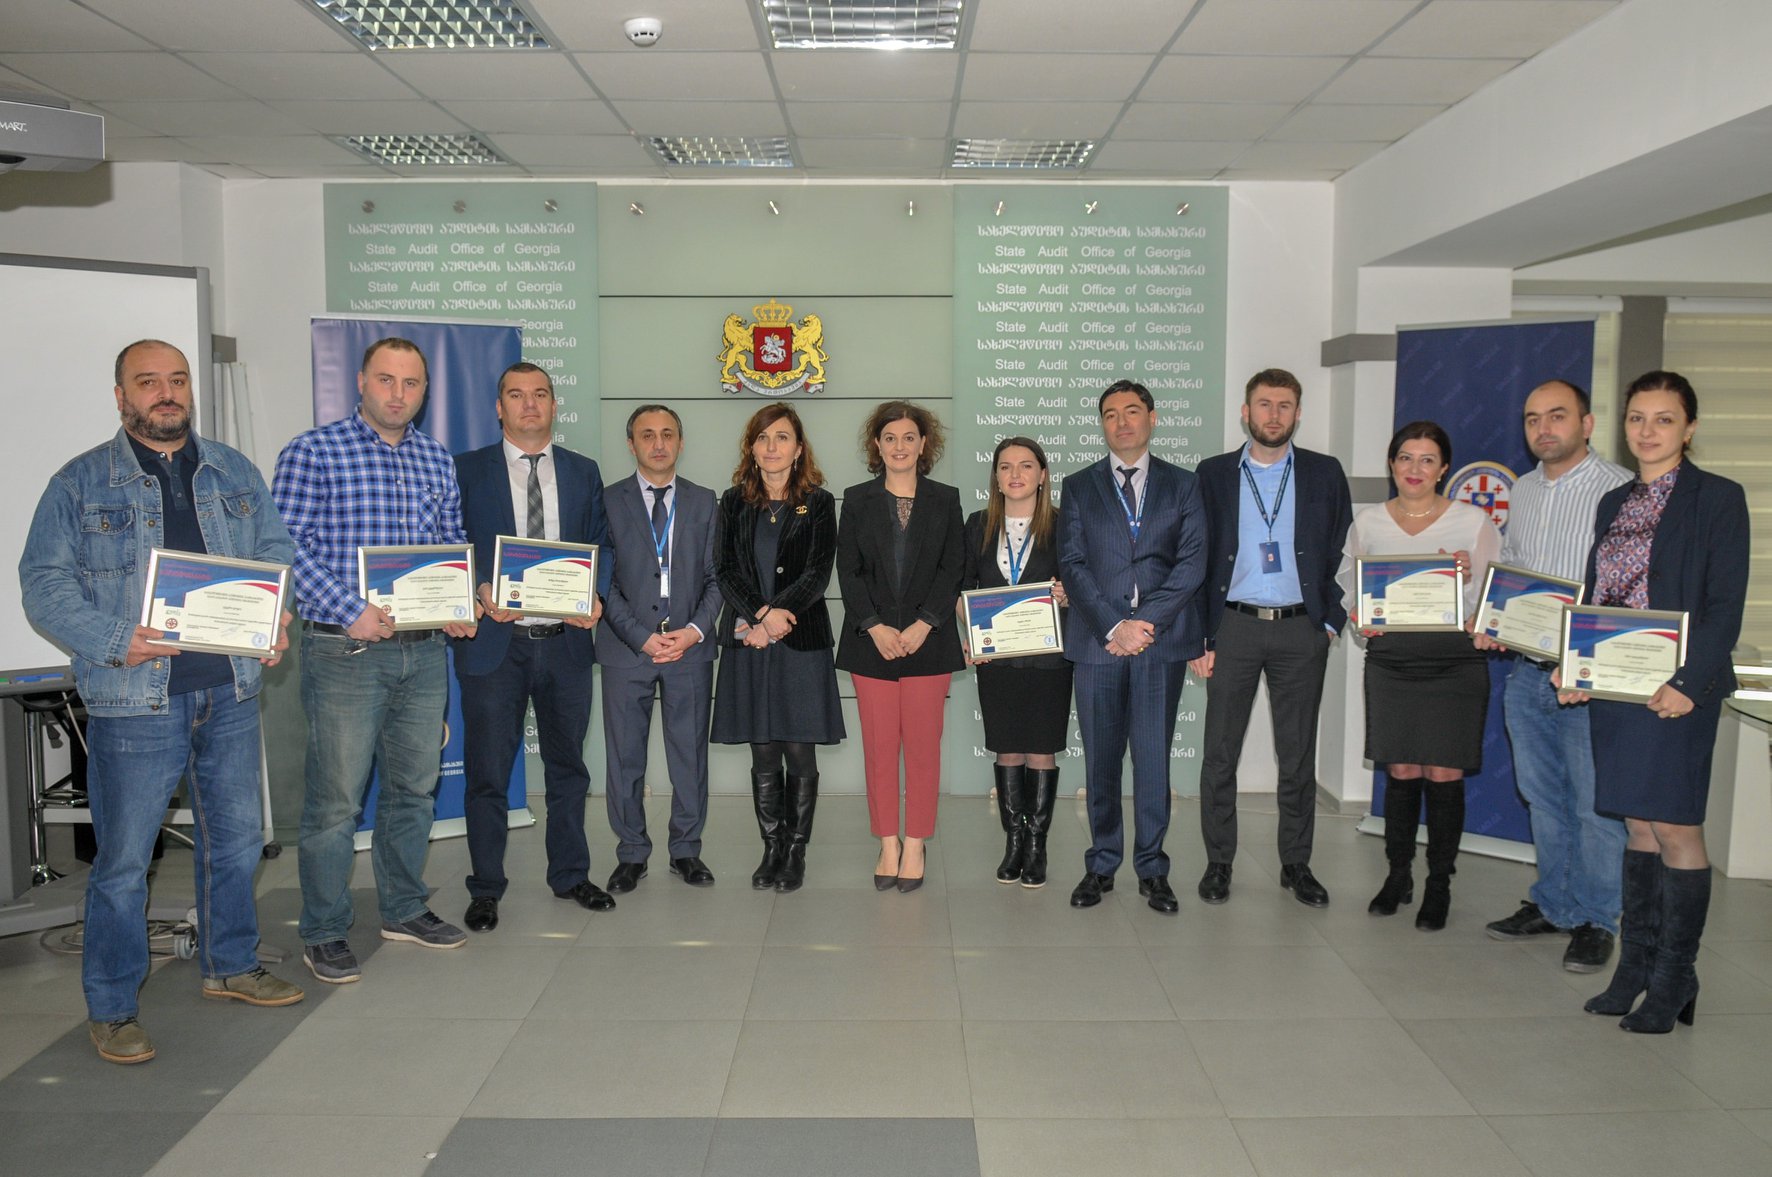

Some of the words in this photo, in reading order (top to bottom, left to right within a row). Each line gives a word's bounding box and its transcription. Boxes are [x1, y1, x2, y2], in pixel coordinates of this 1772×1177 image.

[0, 122, 26, 132] MART
[365, 243, 397, 255] State
[407, 243, 439, 255] Audit
[450, 243, 485, 255] Office
[493, 243, 506, 255] of
[513, 243, 561, 257] Georgia
[994, 245, 1026, 257] State
[1037, 246, 1069, 258] Audit
[1081, 246, 1116, 258] Office
[1124, 246, 1137, 258] of
[1144, 246, 1192, 261] Georgia
[367, 280, 399, 292] State
[409, 280, 441, 292] Audit
[452, 280, 487, 292] Office
[495, 280, 508, 292] of
[516, 281, 563, 295] Georgia
[995, 283, 1027, 295] State
[1038, 283, 1070, 296] Audit
[1081, 284, 1117, 296] Office
[1124, 284, 1138, 296] of
[1145, 284, 1192, 299] Georgia
[995, 321, 1027, 333] State
[1037, 321, 1070, 333] Audit
[1081, 322, 1116, 334] Office
[1124, 322, 1137, 334] of
[1145, 322, 1192, 337] Georgia
[522, 336, 577, 348] მსახური
[994, 359, 1026, 371] State
[1037, 359, 1069, 371] Audit
[1080, 359, 1115, 371] Office
[1123, 359, 1136, 371] of
[1144, 360, 1191, 374] Georgia
[994, 396, 1026, 408] State
[1037, 397, 1068, 408] Audit
[1153, 398, 1190, 412] eorgia
[1036, 434, 1067, 446] Audit
[1079, 434, 1105, 446] Offic
[1150, 436, 1189, 449] eorgia
